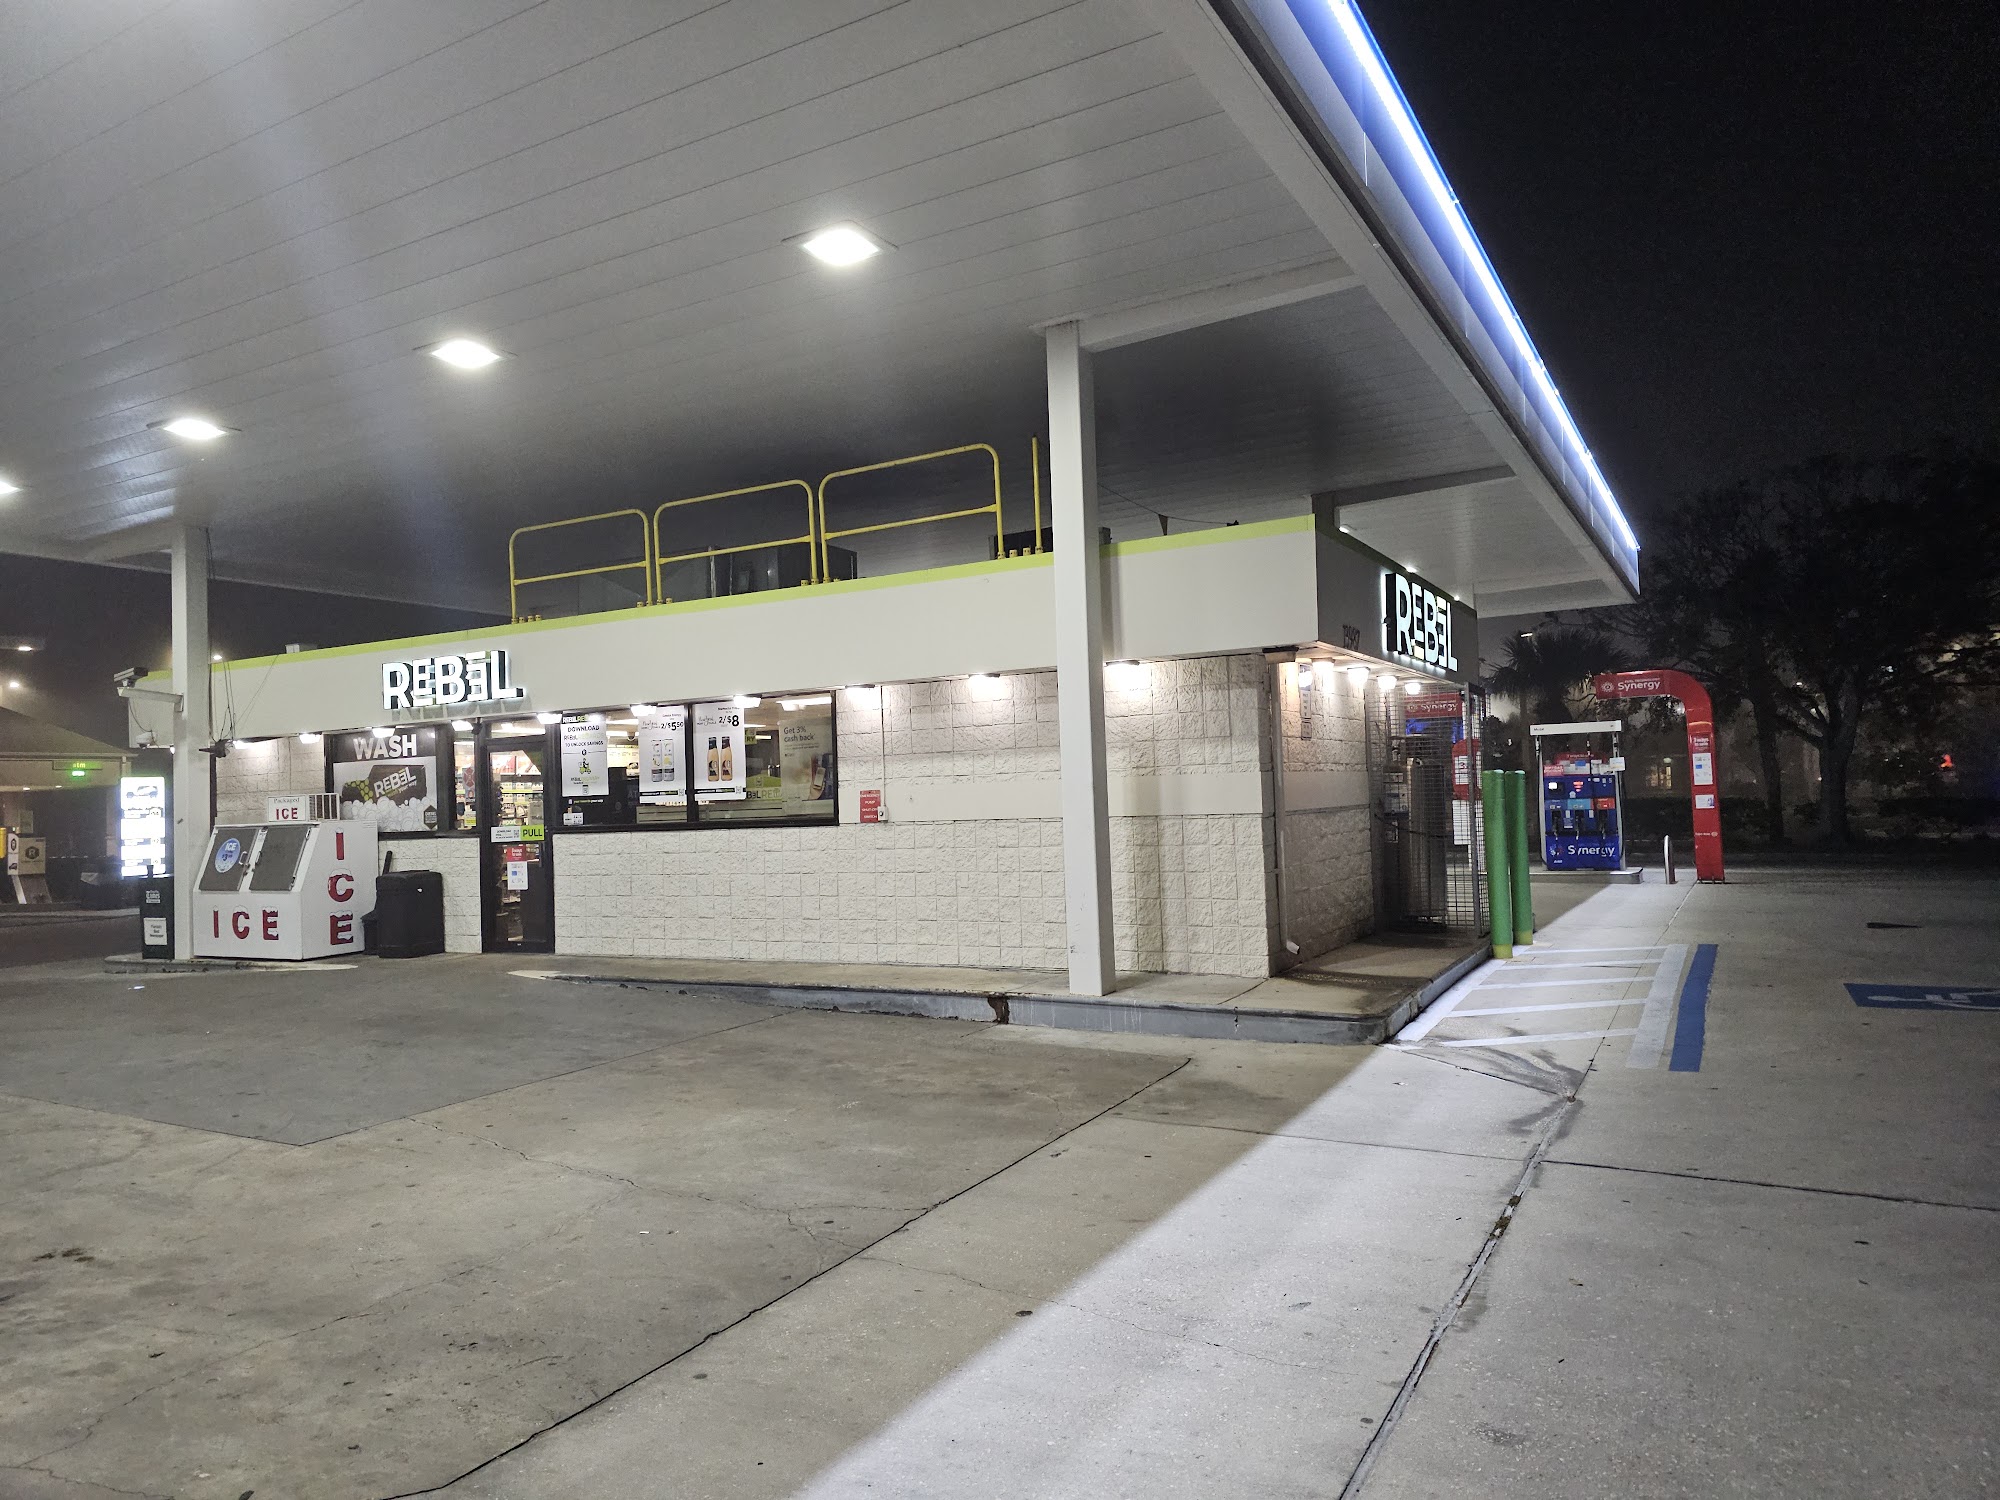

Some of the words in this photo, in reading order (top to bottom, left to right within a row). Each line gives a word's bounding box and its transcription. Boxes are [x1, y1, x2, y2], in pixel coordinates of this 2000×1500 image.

[1394, 573, 1458, 671] REBEL
[382, 650, 521, 710] REBEL
[1617, 681, 1661, 692] Synergy
[1421, 702, 1458, 712] Synergy
[567, 725, 600, 733] DOWNLOAD
[783, 727, 795, 735] Get
[796, 725, 807, 734] 3%
[799, 733, 814, 741] back
[353, 734, 417, 761] WASH
[373, 766, 417, 798] REBEL
[274, 797, 300, 805] Packaged
[275, 807, 299, 820] ICE
[522, 829, 543, 838] PULL
[224, 842, 238, 851] ICE
[1567, 844, 1616, 858] Synergy
[213, 905, 280, 941] ICE
